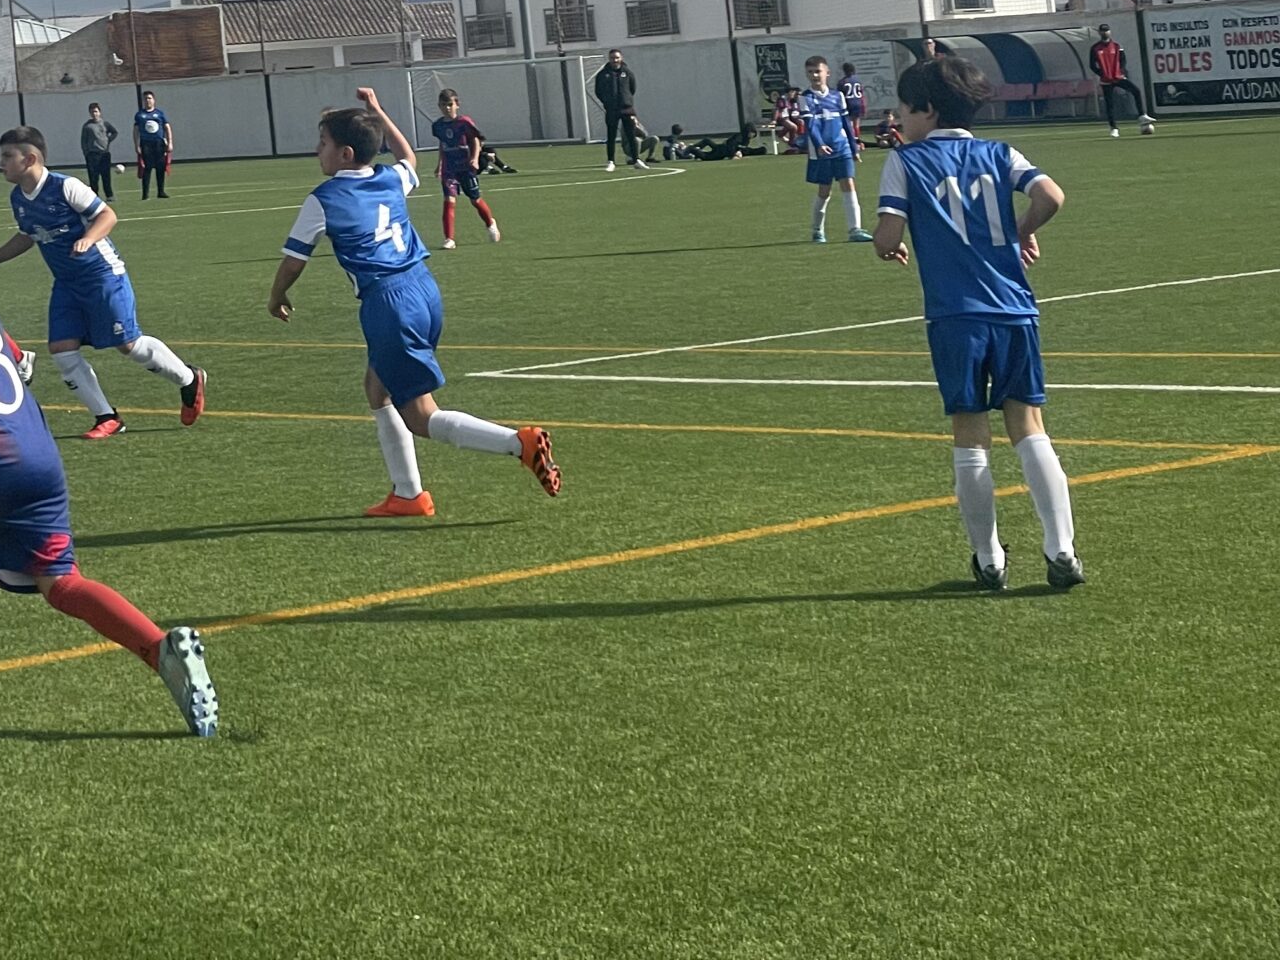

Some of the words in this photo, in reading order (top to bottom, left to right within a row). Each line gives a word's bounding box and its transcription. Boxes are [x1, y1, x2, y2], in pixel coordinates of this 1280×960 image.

[1151, 22, 1168, 32] TUS
[1222, 18, 1239, 28] CON
[1240, 15, 1280, 28] RESPETO
[1152, 38, 1166, 50] NO
[1168, 35, 1212, 50] MARCAN
[1223, 30, 1280, 46] GANAMOS
[1154, 51, 1213, 74] GOLES
[1226, 47, 1280, 70] TODOS
[935, 174, 1006, 247] 11
[374, 203, 407, 253] 4
